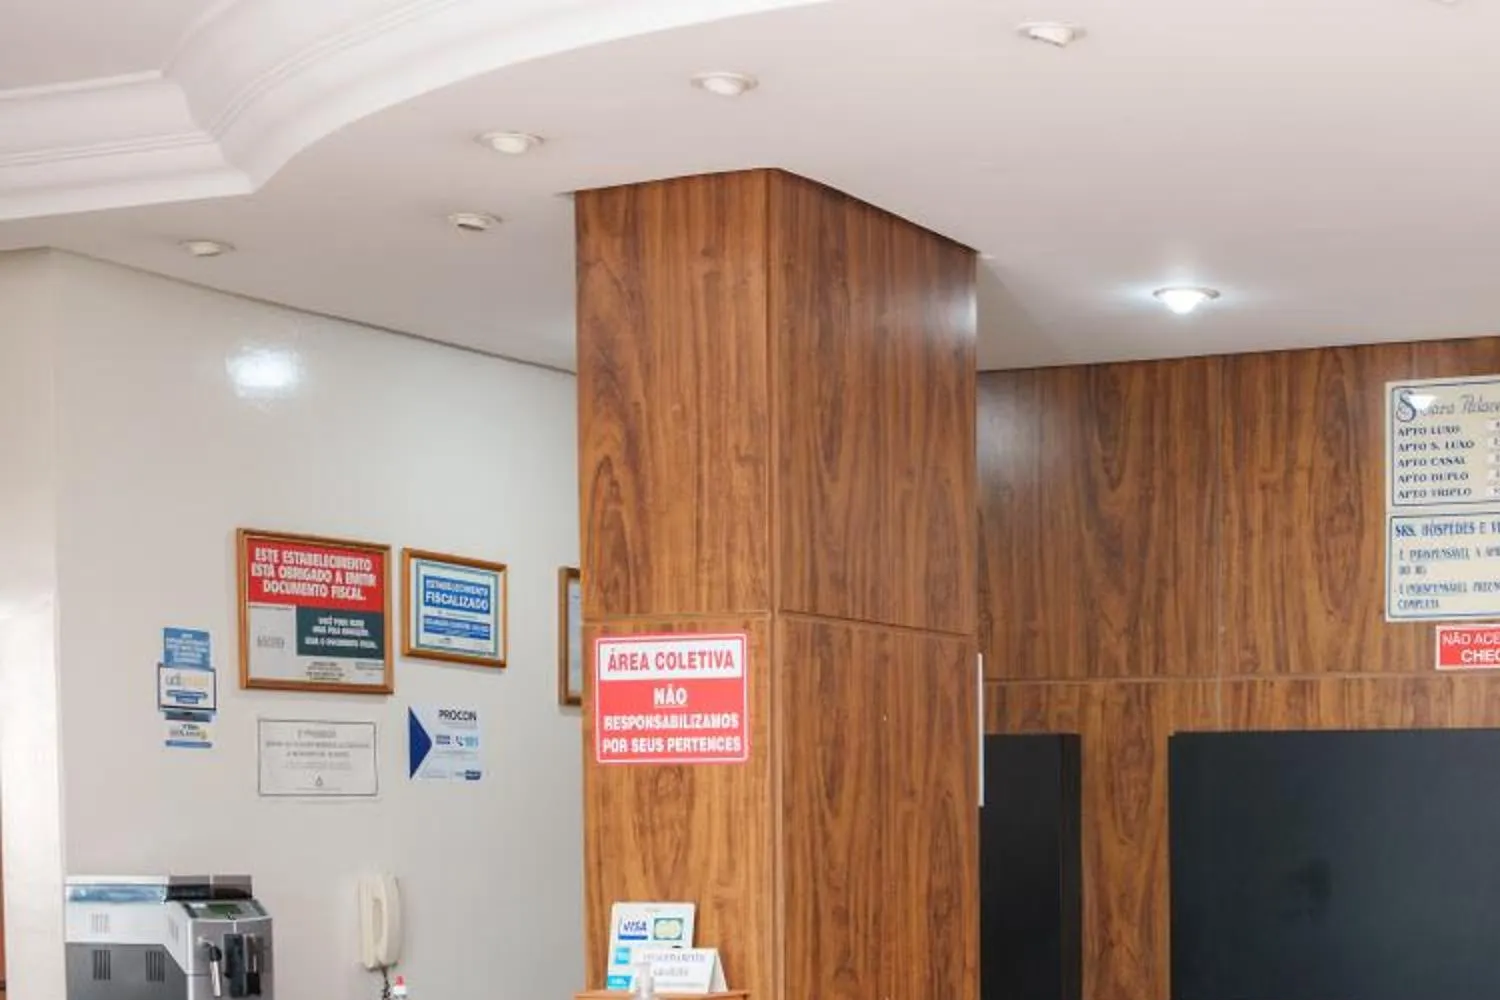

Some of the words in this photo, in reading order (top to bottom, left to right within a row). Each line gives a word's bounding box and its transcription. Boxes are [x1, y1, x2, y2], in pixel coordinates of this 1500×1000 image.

[1397, 427, 1427, 437] APTO
[1431, 425, 1461, 435] LUXO
[1397, 443, 1427, 453] APTO
[1444, 440, 1475, 450] LUXO
[1397, 458, 1427, 468] APTO
[1430, 456, 1466, 466] CASAL
[1397, 474, 1427, 484] APTO
[1430, 472, 1469, 482] DUPLO
[1397, 489, 1427, 499] APTO
[1431, 488, 1473, 498] TRIPLO
[1479, 521, 1486, 534] E
[255, 547, 280, 564] ESTE
[283, 550, 373, 572] ESTABELECIMENTO
[278, 566, 333, 584] OBRIGADO
[334, 571, 343, 584] A
[262, 579, 329, 599] DOCUMENTO
[425, 590, 489, 611] FISCALIZADO
[1442, 631, 1472, 645] NÃO
[607, 647, 651, 672] ÁREA
[655, 650, 736, 671] COLETIVA
[653, 684, 688, 706] NÃO
[437, 708, 477, 722] PROCON
[603, 712, 740, 732] RESPONSABILIZAMOS
[603, 737, 628, 753] POR
[631, 737, 665, 753] SEUS
[667, 736, 742, 753] PERTENCES
